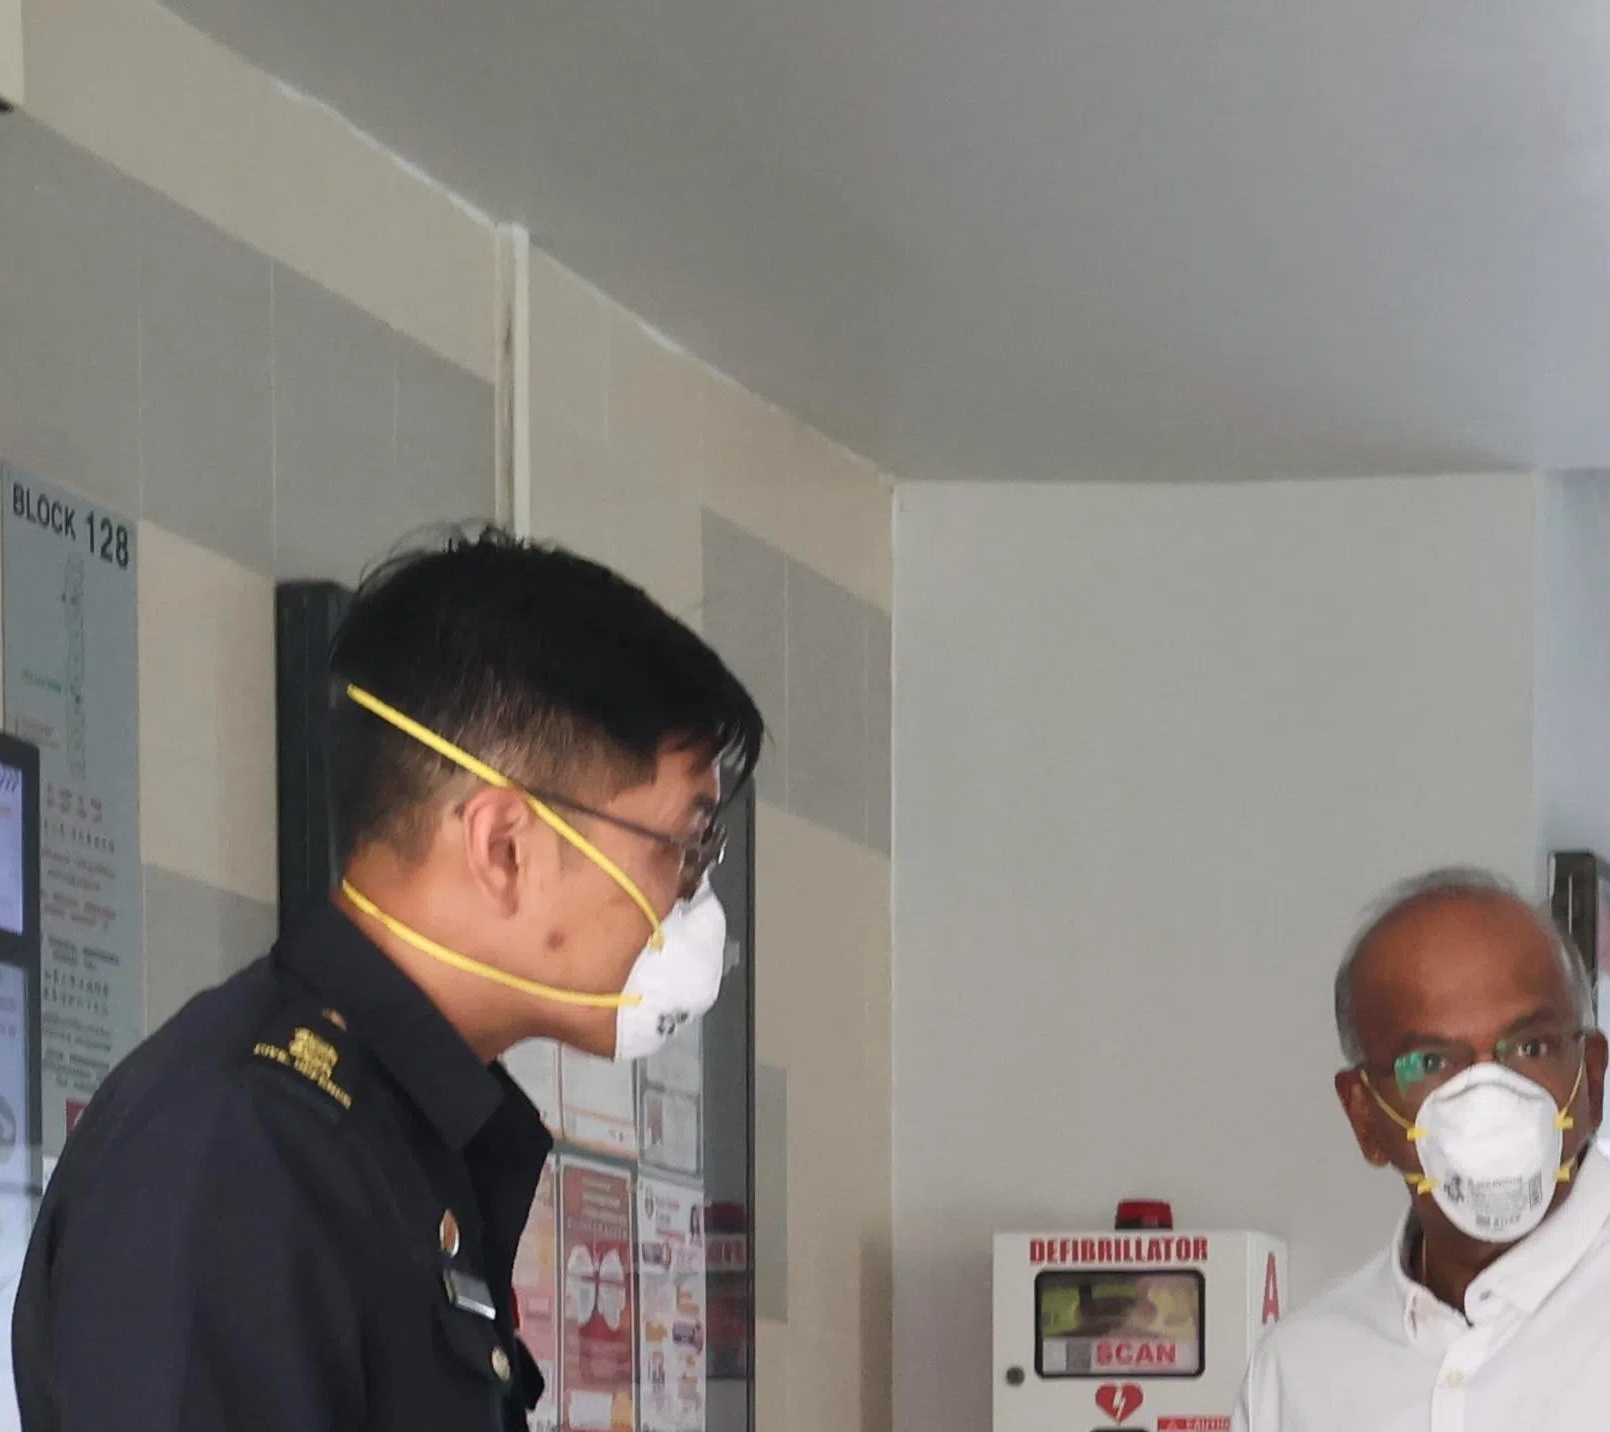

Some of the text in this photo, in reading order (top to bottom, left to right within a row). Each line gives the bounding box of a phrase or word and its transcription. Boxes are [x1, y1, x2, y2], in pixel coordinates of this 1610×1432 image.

[13, 482, 129, 570] BLOCK 128
[1030, 1236, 1208, 1264] DEFIBRILLATOR
[1096, 1340, 1177, 1366] SCAN
